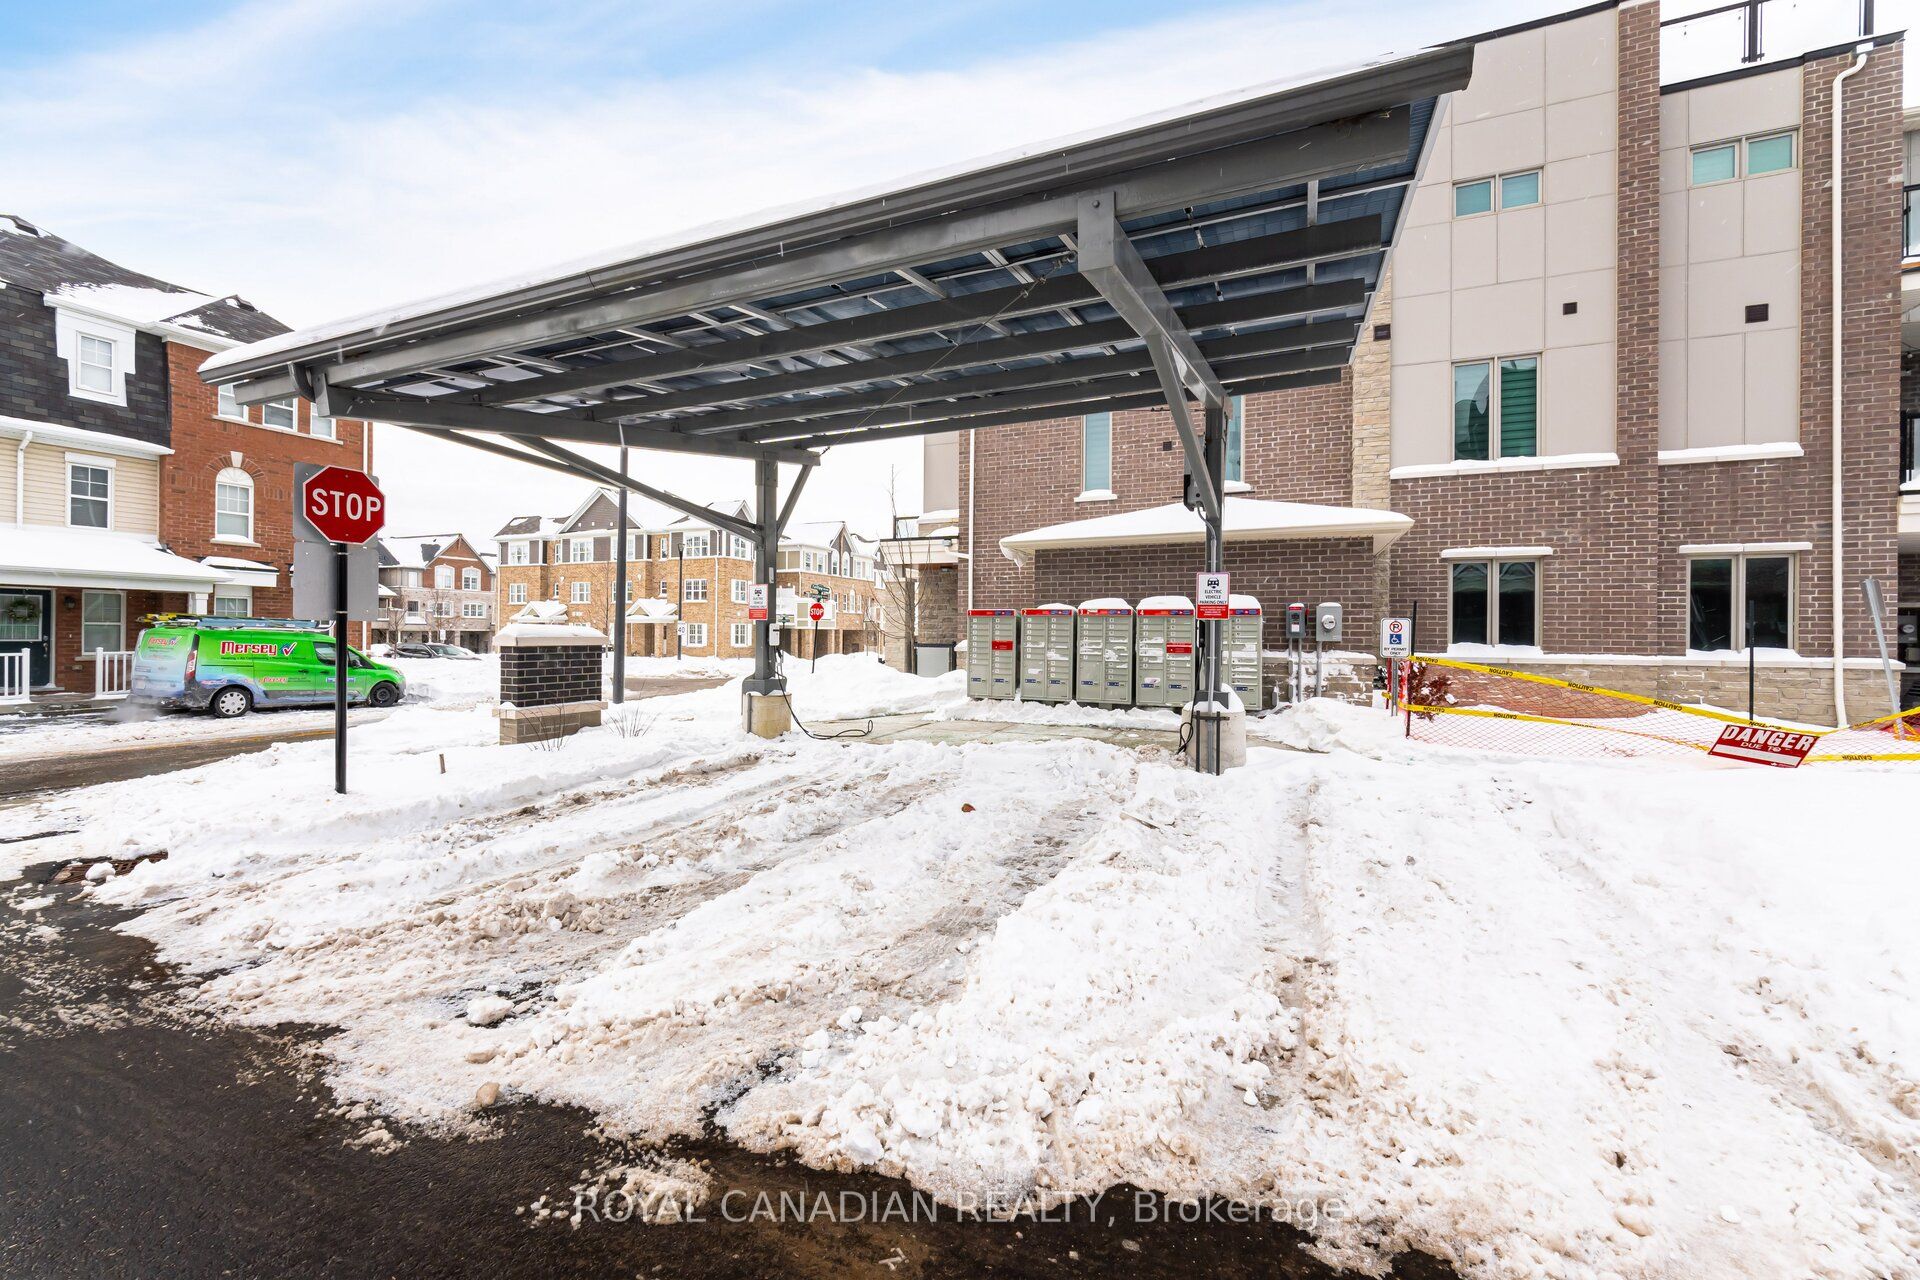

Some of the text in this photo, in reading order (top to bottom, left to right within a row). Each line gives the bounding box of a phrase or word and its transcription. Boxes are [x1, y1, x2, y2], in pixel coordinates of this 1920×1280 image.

[312, 488, 382, 522] STOP
[221, 641, 277, 656] Mersey
[1415, 656, 1439, 664] CAUTION
[1488, 668, 1514, 677] CAUTION
[1568, 682, 1594, 691] CAUTION
[1653, 700, 1683, 711] CAUTION
[1721, 726, 1813, 751] DANGER
[1740, 742, 1763, 750] DUE
